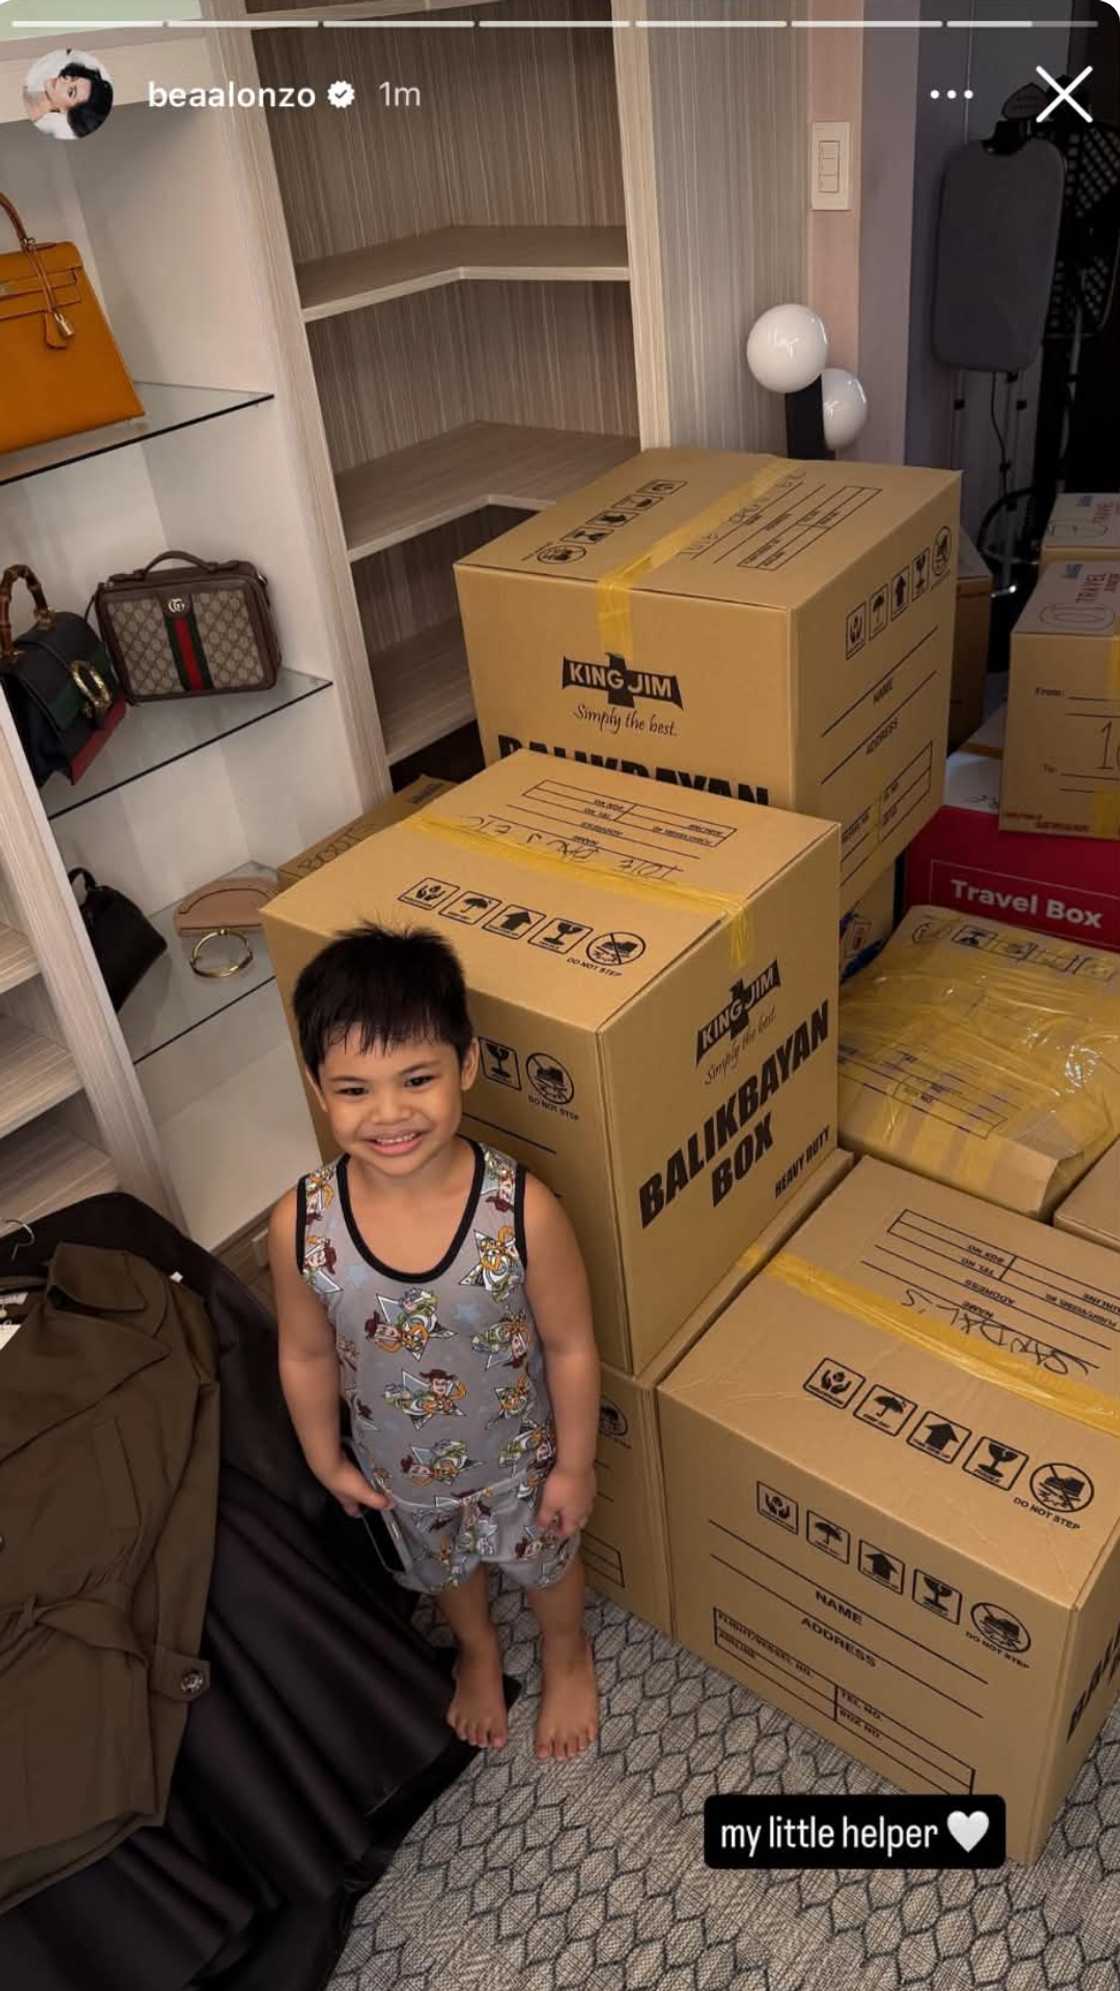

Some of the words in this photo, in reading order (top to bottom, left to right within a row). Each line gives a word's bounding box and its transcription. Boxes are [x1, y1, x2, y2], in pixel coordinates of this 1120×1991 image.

[569, 661, 625, 690] KING
[627, 672, 673, 698] JIM
[573, 703, 622, 735] Simply
[624, 709, 646, 732] the
[951, 878, 1039, 916] Travel
[1045, 897, 1104, 929] Box
[566, 957, 581, 966] DO
[579, 962, 600, 972] NOT
[599, 967, 624, 977] STEP
[702, 998, 742, 1050] KING
[744, 967, 775, 1010] JIM
[639, 998, 829, 1230] BALIKBAYAN
[711, 1111, 774, 1208] BOX
[774, 1152, 805, 1200] HEAVY
[805, 1125, 830, 1165] DUTY
[1012, 1496, 1029, 1508] DO
[1028, 1504, 1053, 1520] NOT
[1052, 1515, 1081, 1531] STEP
[814, 1589, 864, 1627] NAME
[800, 1616, 877, 1668] ADDRESS
[965, 1630, 981, 1641] DO
[980, 1637, 1003, 1656] NOT
[1003, 1652, 1031, 1671] STEP
